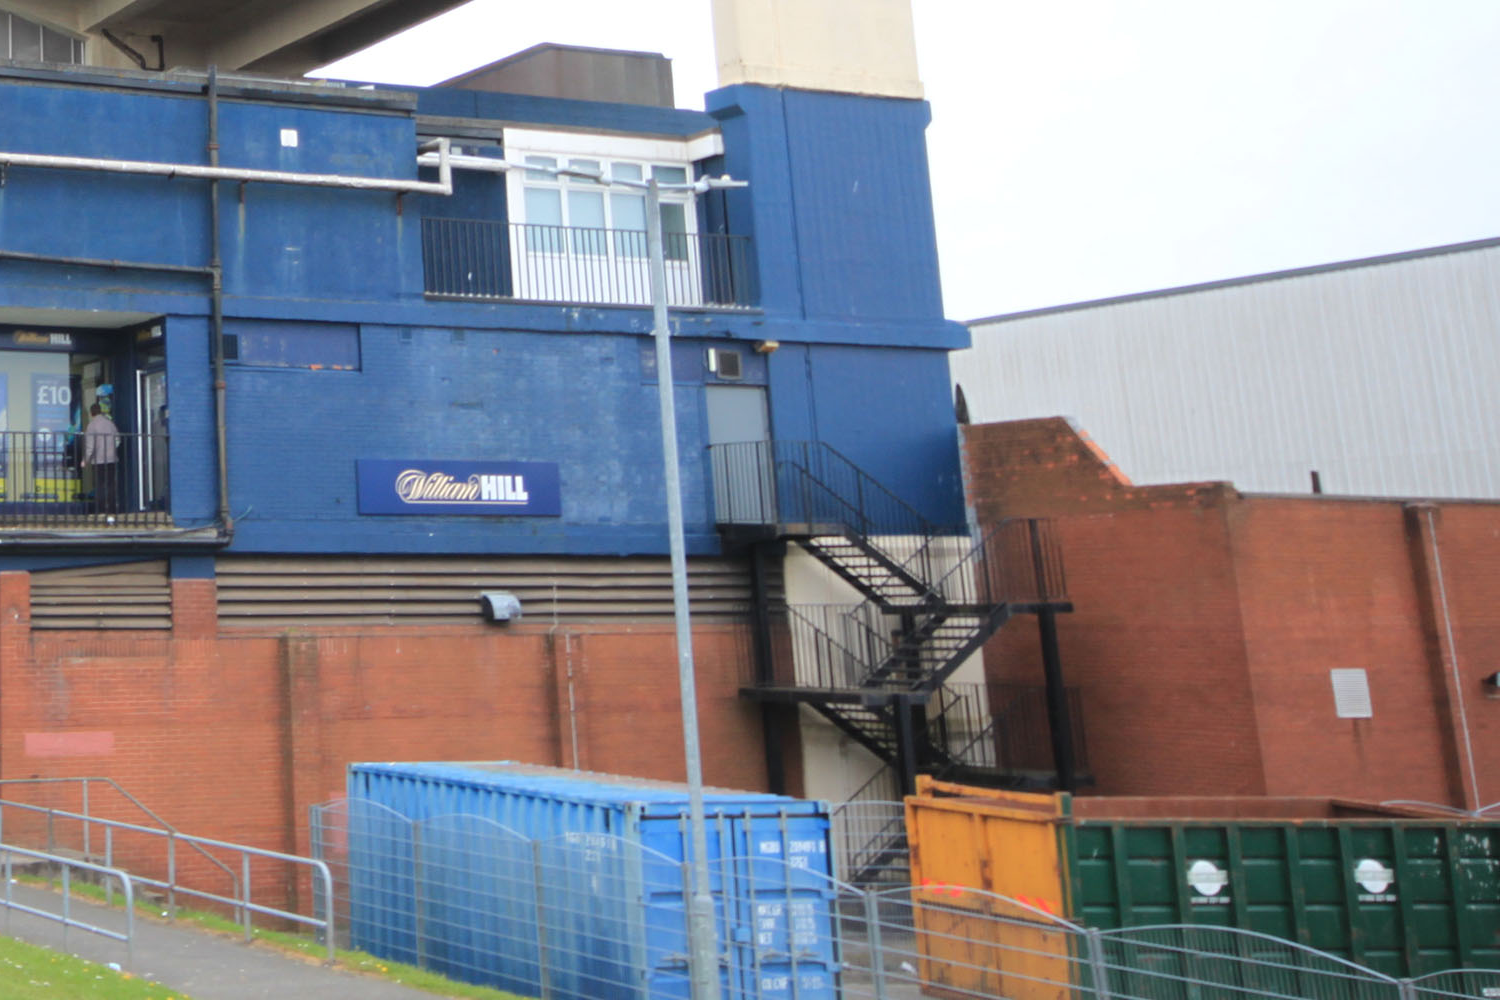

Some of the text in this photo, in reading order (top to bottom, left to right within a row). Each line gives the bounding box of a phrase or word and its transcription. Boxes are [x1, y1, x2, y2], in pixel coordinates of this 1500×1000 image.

[49, 333, 72, 345] HILL
[37, 385, 72, 405] £10
[395, 469, 528, 503] William HILL
